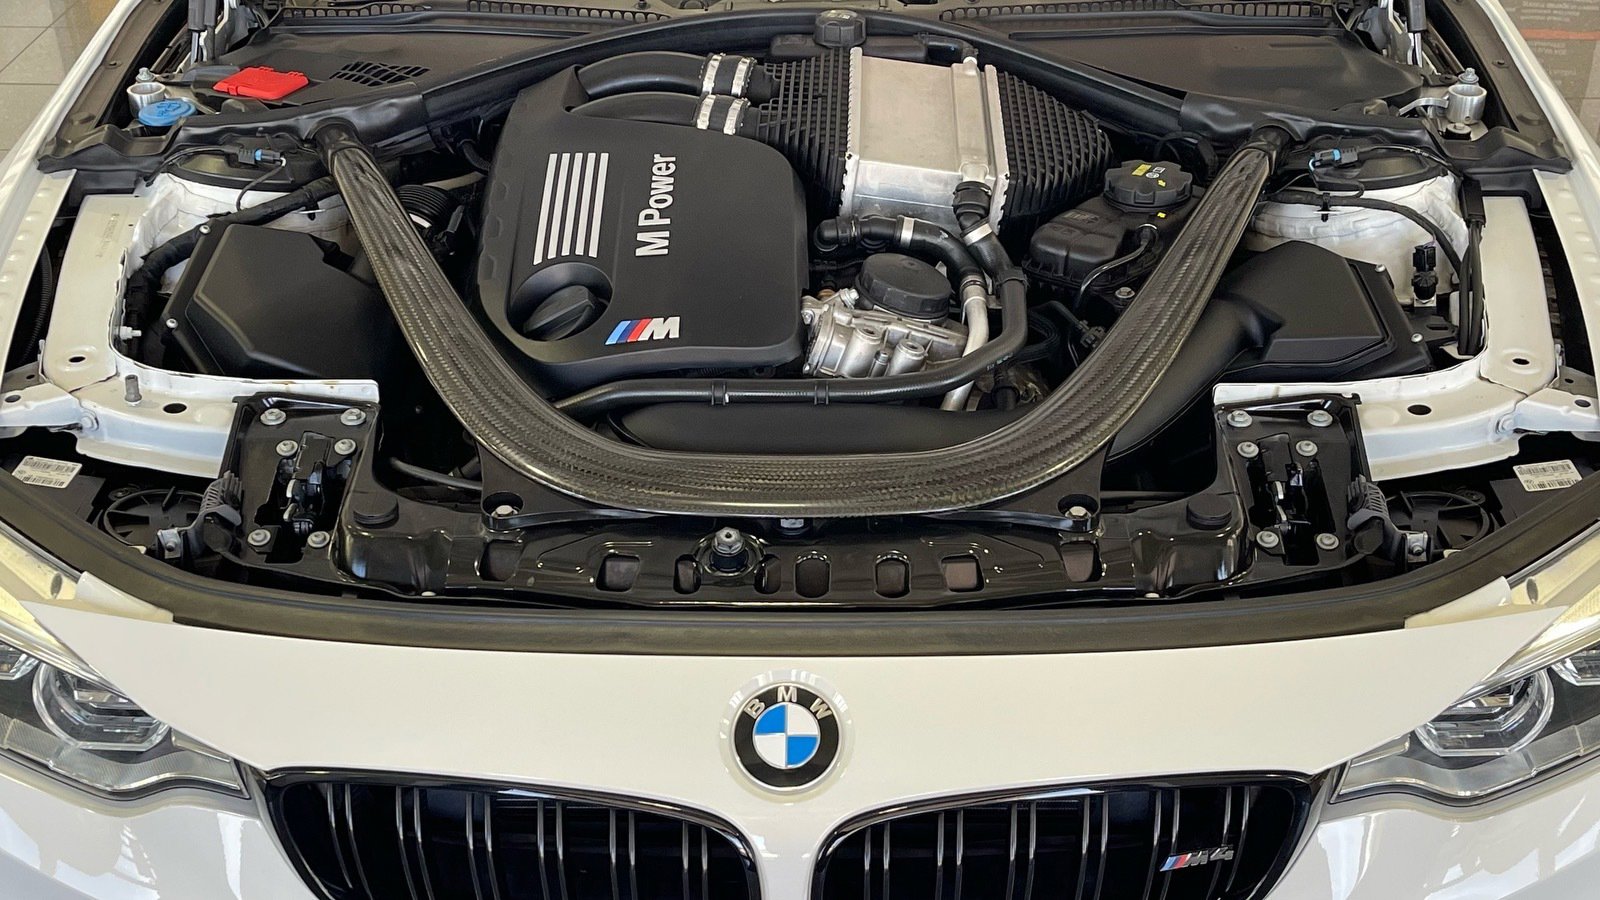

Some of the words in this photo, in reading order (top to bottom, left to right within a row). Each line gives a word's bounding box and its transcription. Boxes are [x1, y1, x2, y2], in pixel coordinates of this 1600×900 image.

[637, 316, 680, 341] M
[743, 686, 833, 720] BMW
[1184, 846, 1234, 867] M4
